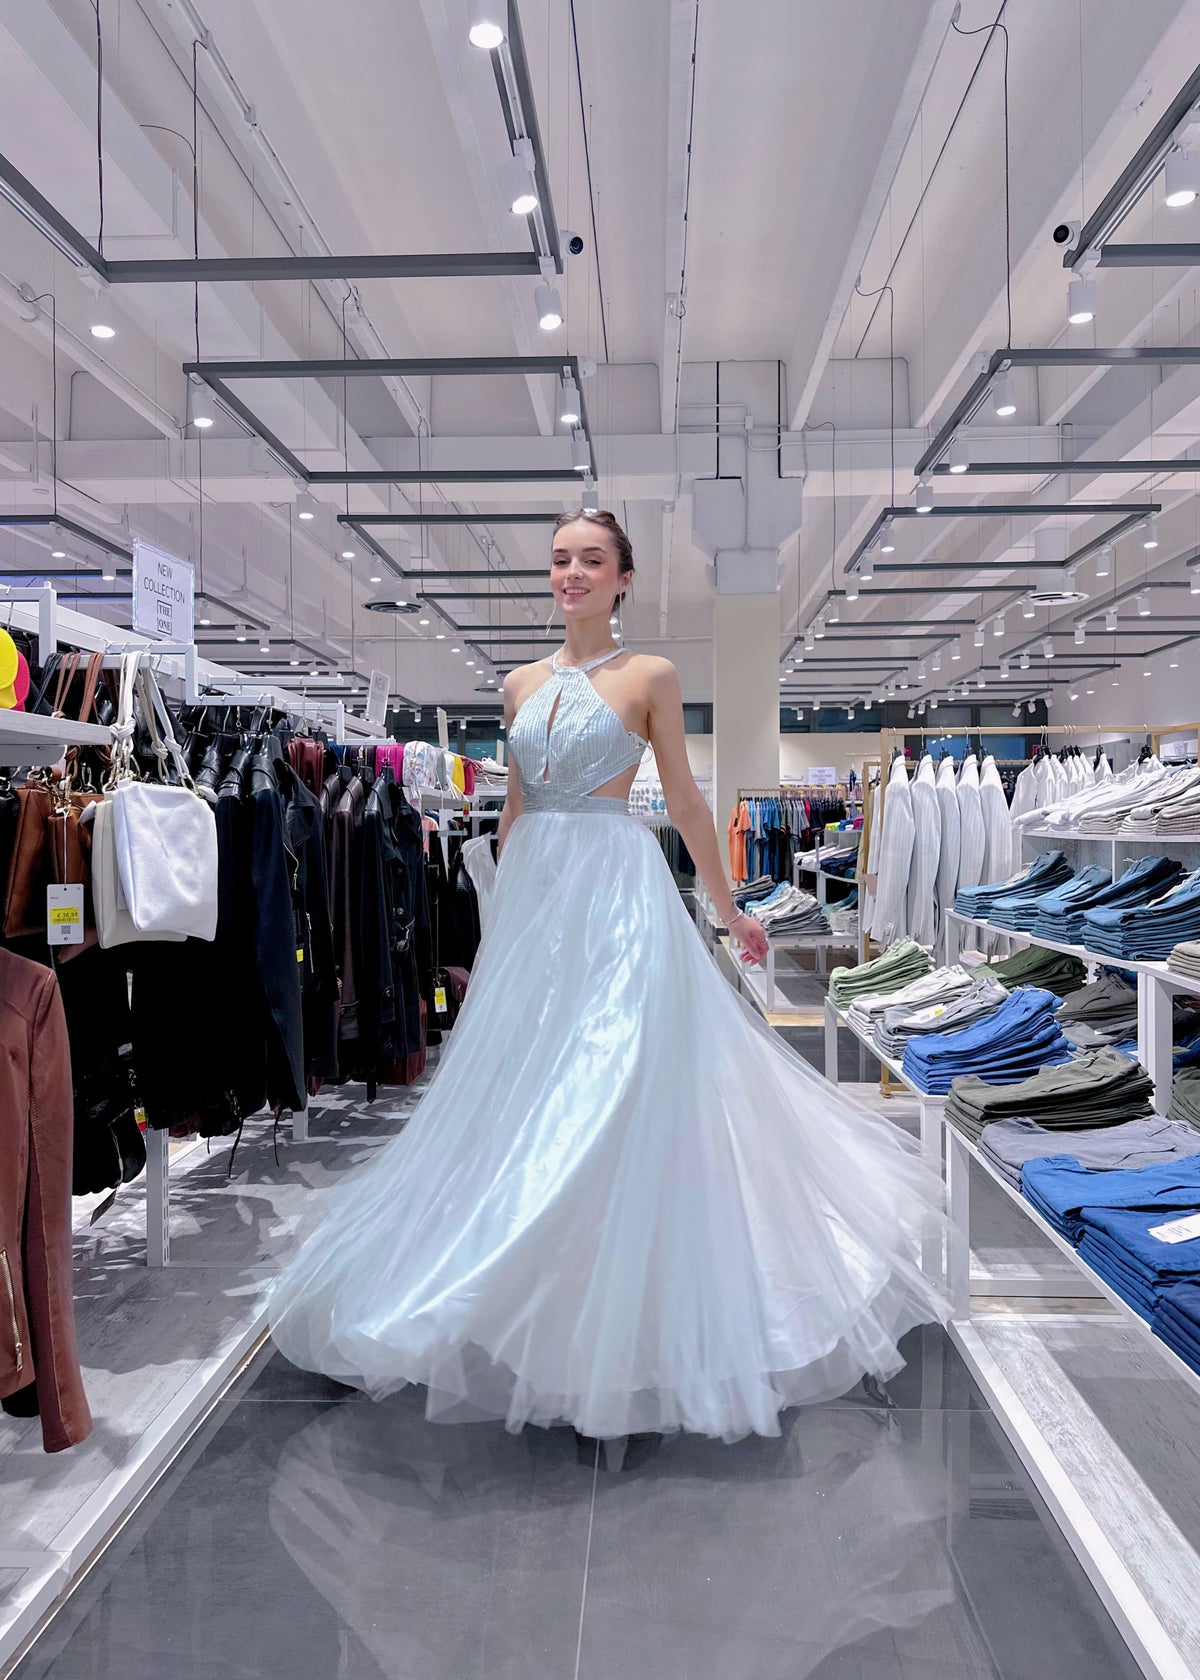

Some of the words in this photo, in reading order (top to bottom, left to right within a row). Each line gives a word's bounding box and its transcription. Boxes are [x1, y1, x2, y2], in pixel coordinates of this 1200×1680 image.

[157, 562, 172, 579] NEW
[144, 577, 185, 603] COLLECTION
[159, 605, 170, 617] THE
[158, 619, 170, 631] ONE
